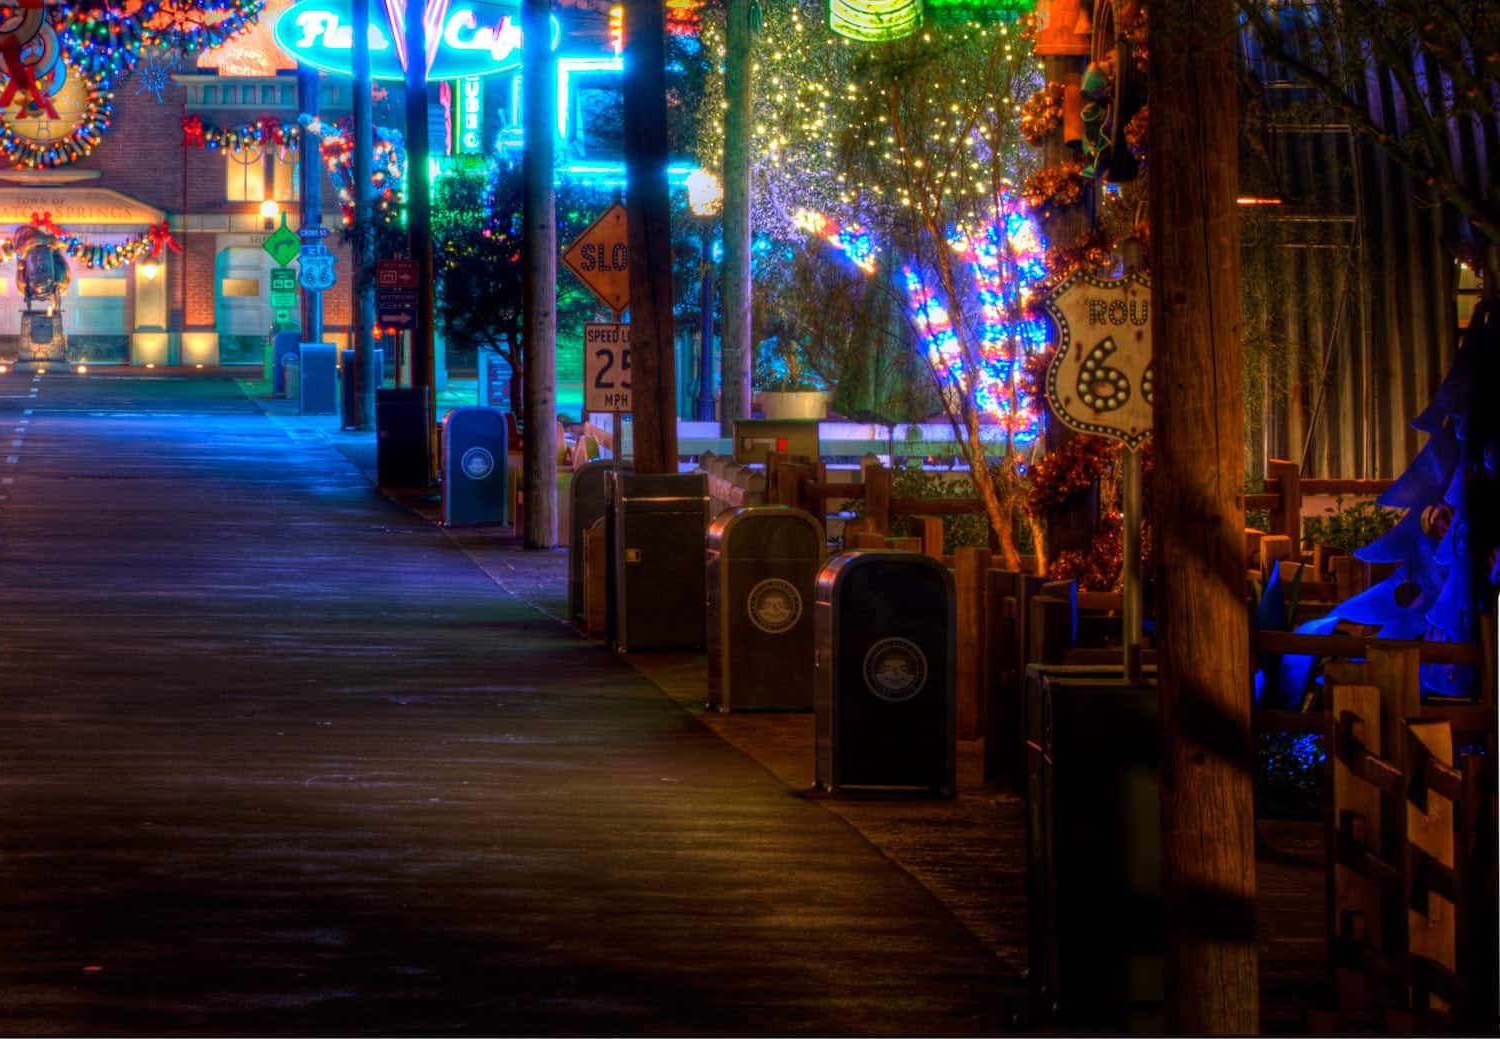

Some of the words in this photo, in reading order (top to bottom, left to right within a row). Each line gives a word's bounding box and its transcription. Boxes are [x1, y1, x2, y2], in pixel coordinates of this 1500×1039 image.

[53, 206, 134, 219] SPRINGS
[580, 243, 629, 272] SLO
[1088, 299, 1149, 326] ROU
[587, 329, 619, 343] SPEED
[604, 394, 628, 407] MPH
